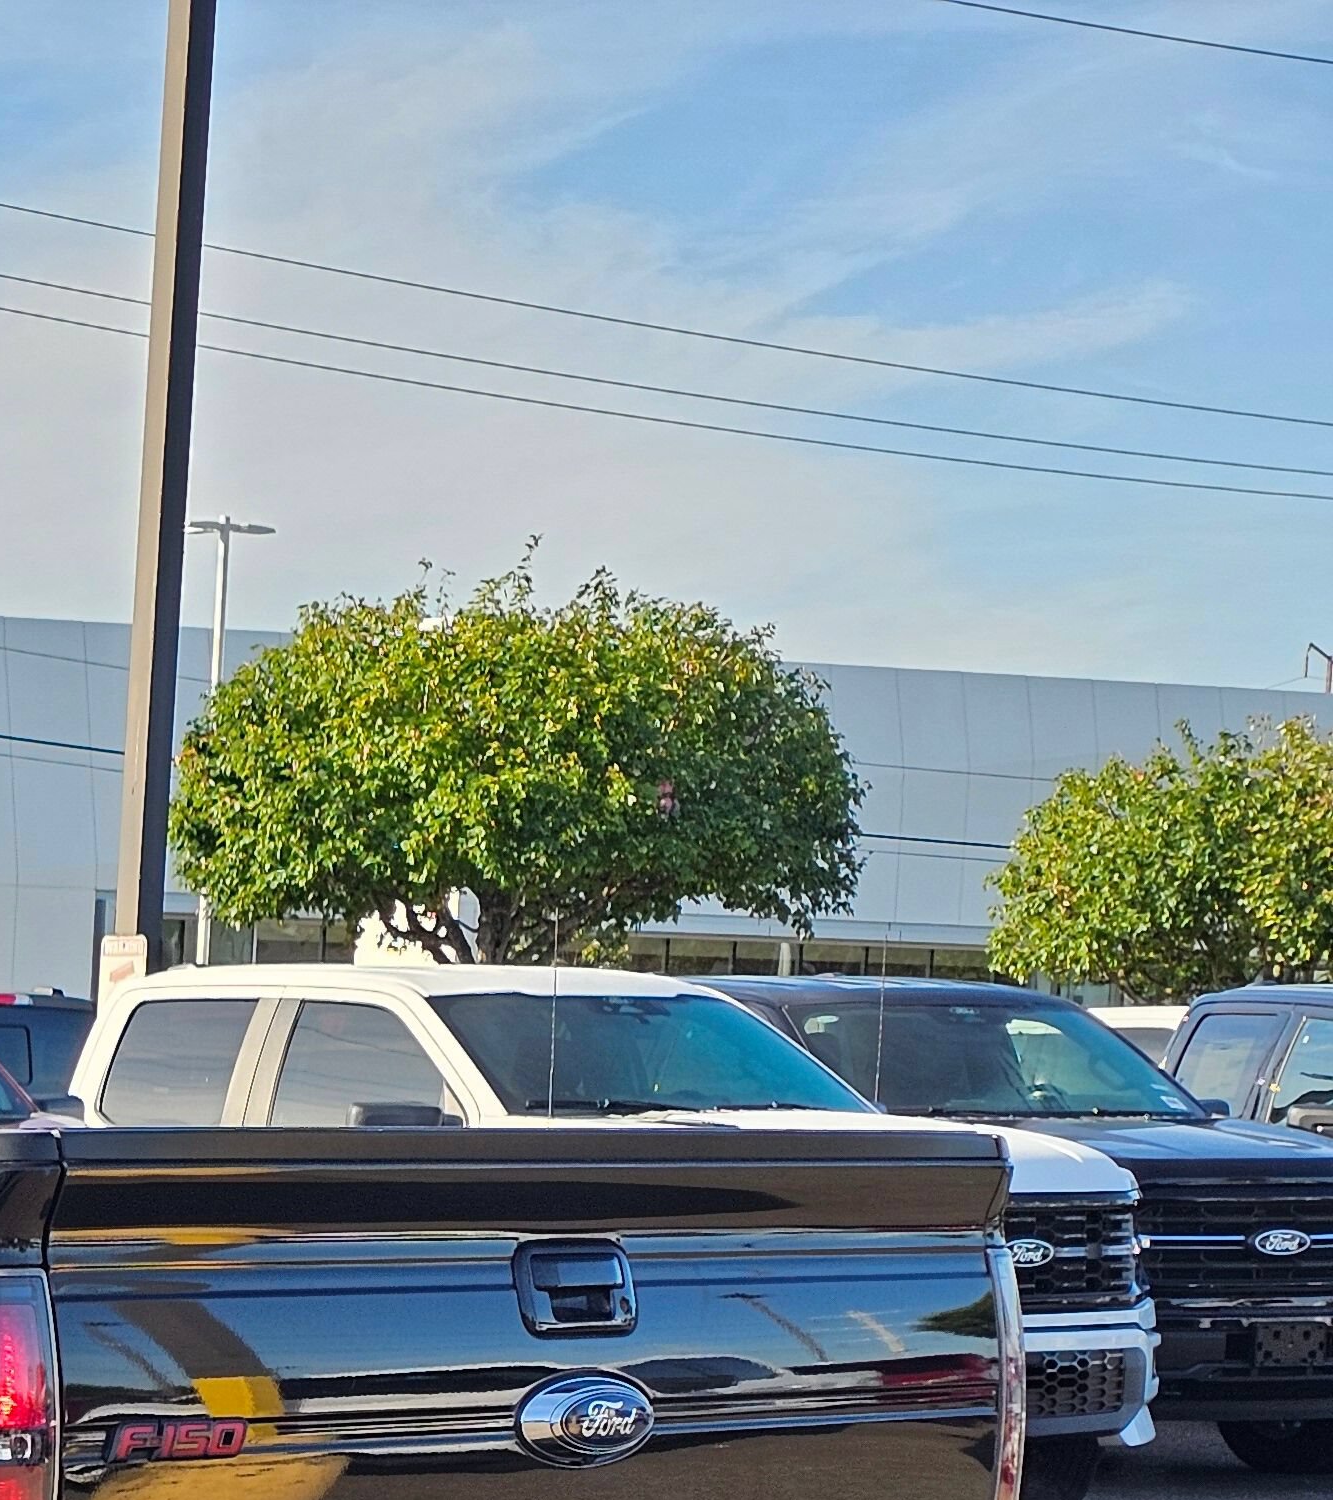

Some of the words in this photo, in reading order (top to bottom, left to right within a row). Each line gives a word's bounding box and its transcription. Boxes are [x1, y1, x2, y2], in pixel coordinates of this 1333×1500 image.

[1012, 1243, 1044, 1263] Ford
[1265, 1234, 1301, 1251] Ford
[580, 1400, 637, 1438] Ford
[115, 1421, 246, 1462] F-150
